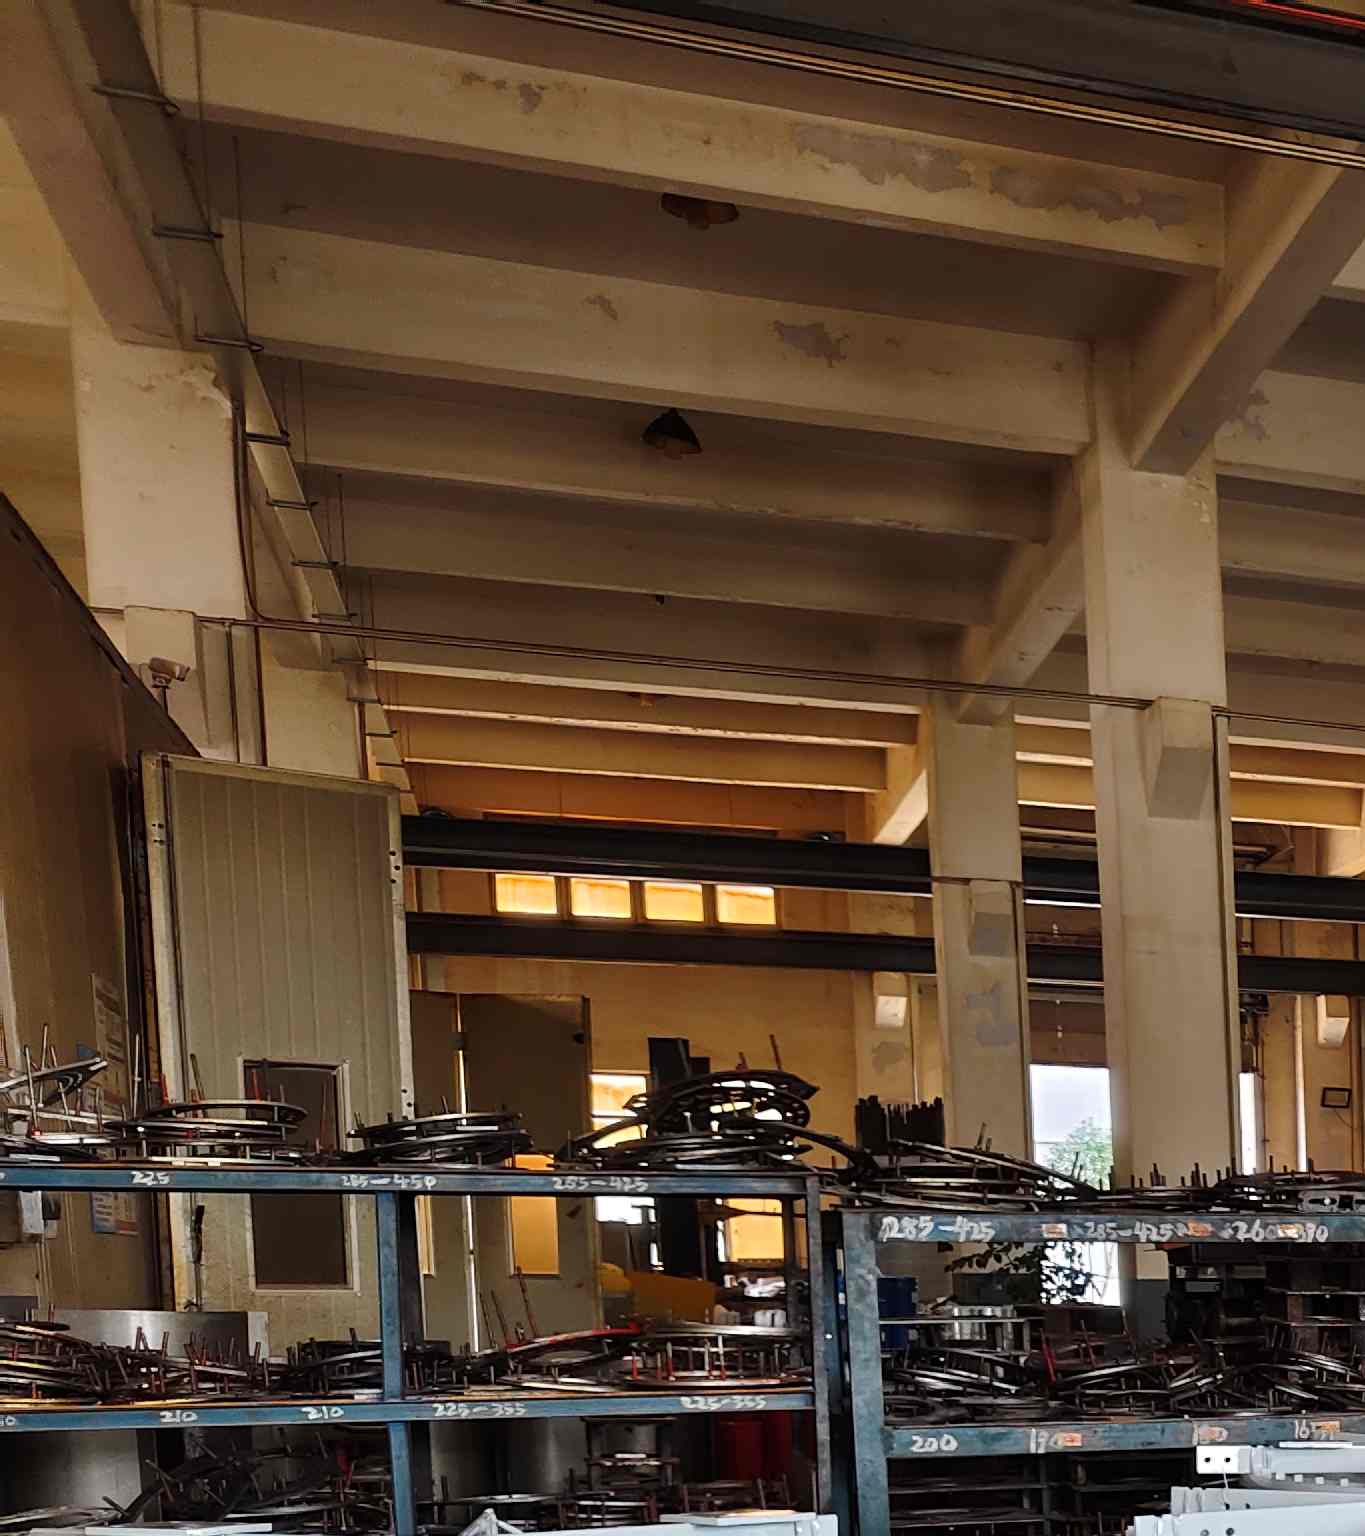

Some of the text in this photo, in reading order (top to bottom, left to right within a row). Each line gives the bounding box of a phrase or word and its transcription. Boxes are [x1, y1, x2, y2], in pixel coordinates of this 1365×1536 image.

[130, 1171, 170, 1186] 225
[878, 1215, 996, 1242] 285-425
[159, 1410, 198, 1424] 210
[301, 1406, 345, 1420] 210
[910, 1434, 958, 1452] 200
